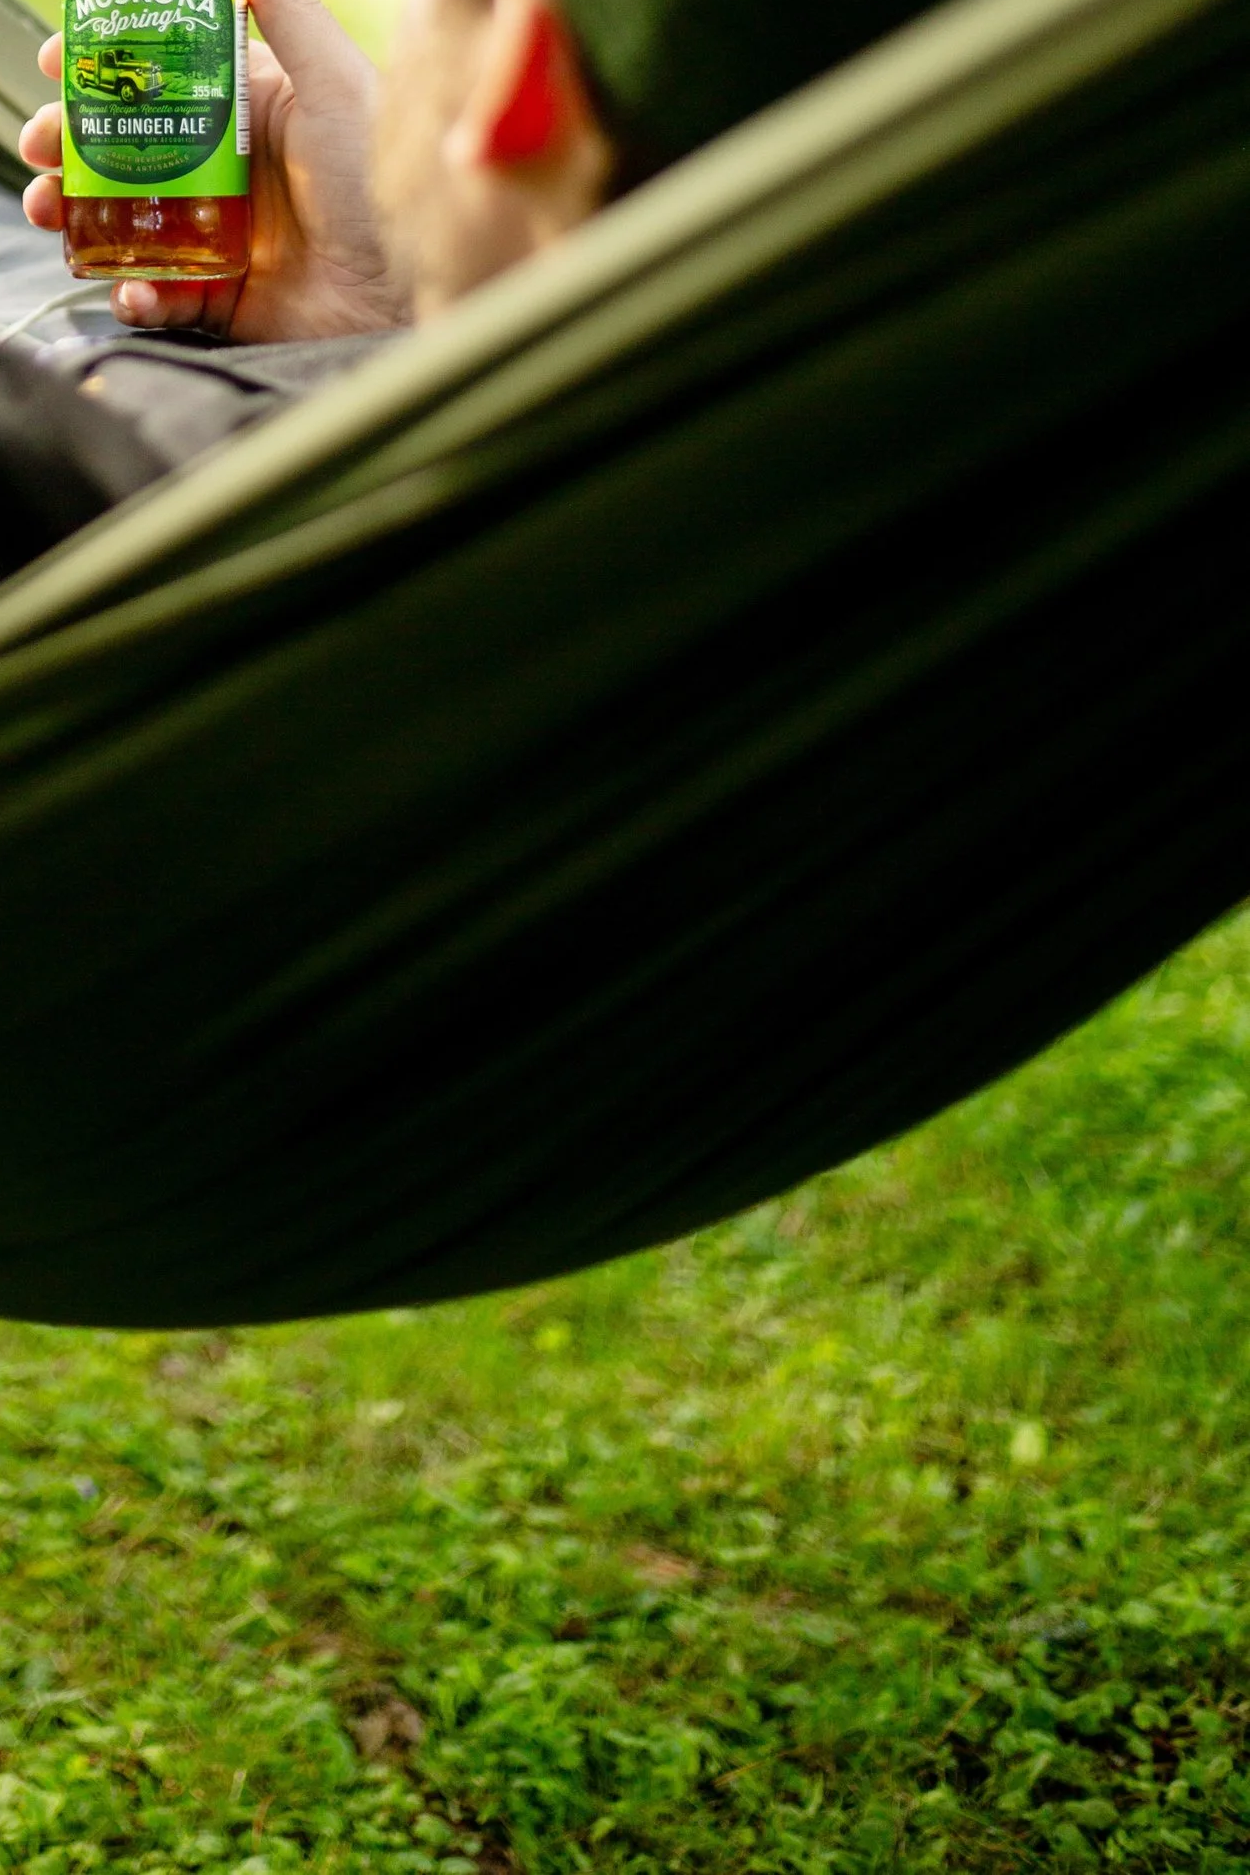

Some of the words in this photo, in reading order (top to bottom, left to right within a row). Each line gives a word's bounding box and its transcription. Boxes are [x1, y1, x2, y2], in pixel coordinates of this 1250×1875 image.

[93, 6, 196, 38] Springs
[192, 86, 210, 98] 355
[78, 104, 108, 116] Original
[109, 104, 137, 116] Recipe
[141, 104, 173, 116] Recette
[174, 104, 211, 115] originale
[81, 117, 112, 135] PALE
[117, 117, 174, 135] GINGER
[179, 117, 207, 135] ALE
[96, 154, 133, 171] BOISSON
[135, 152, 191, 172] ARTISANALE
[106, 150, 133, 162] CRAFT
[134, 149, 178, 163] BEVERAGE
